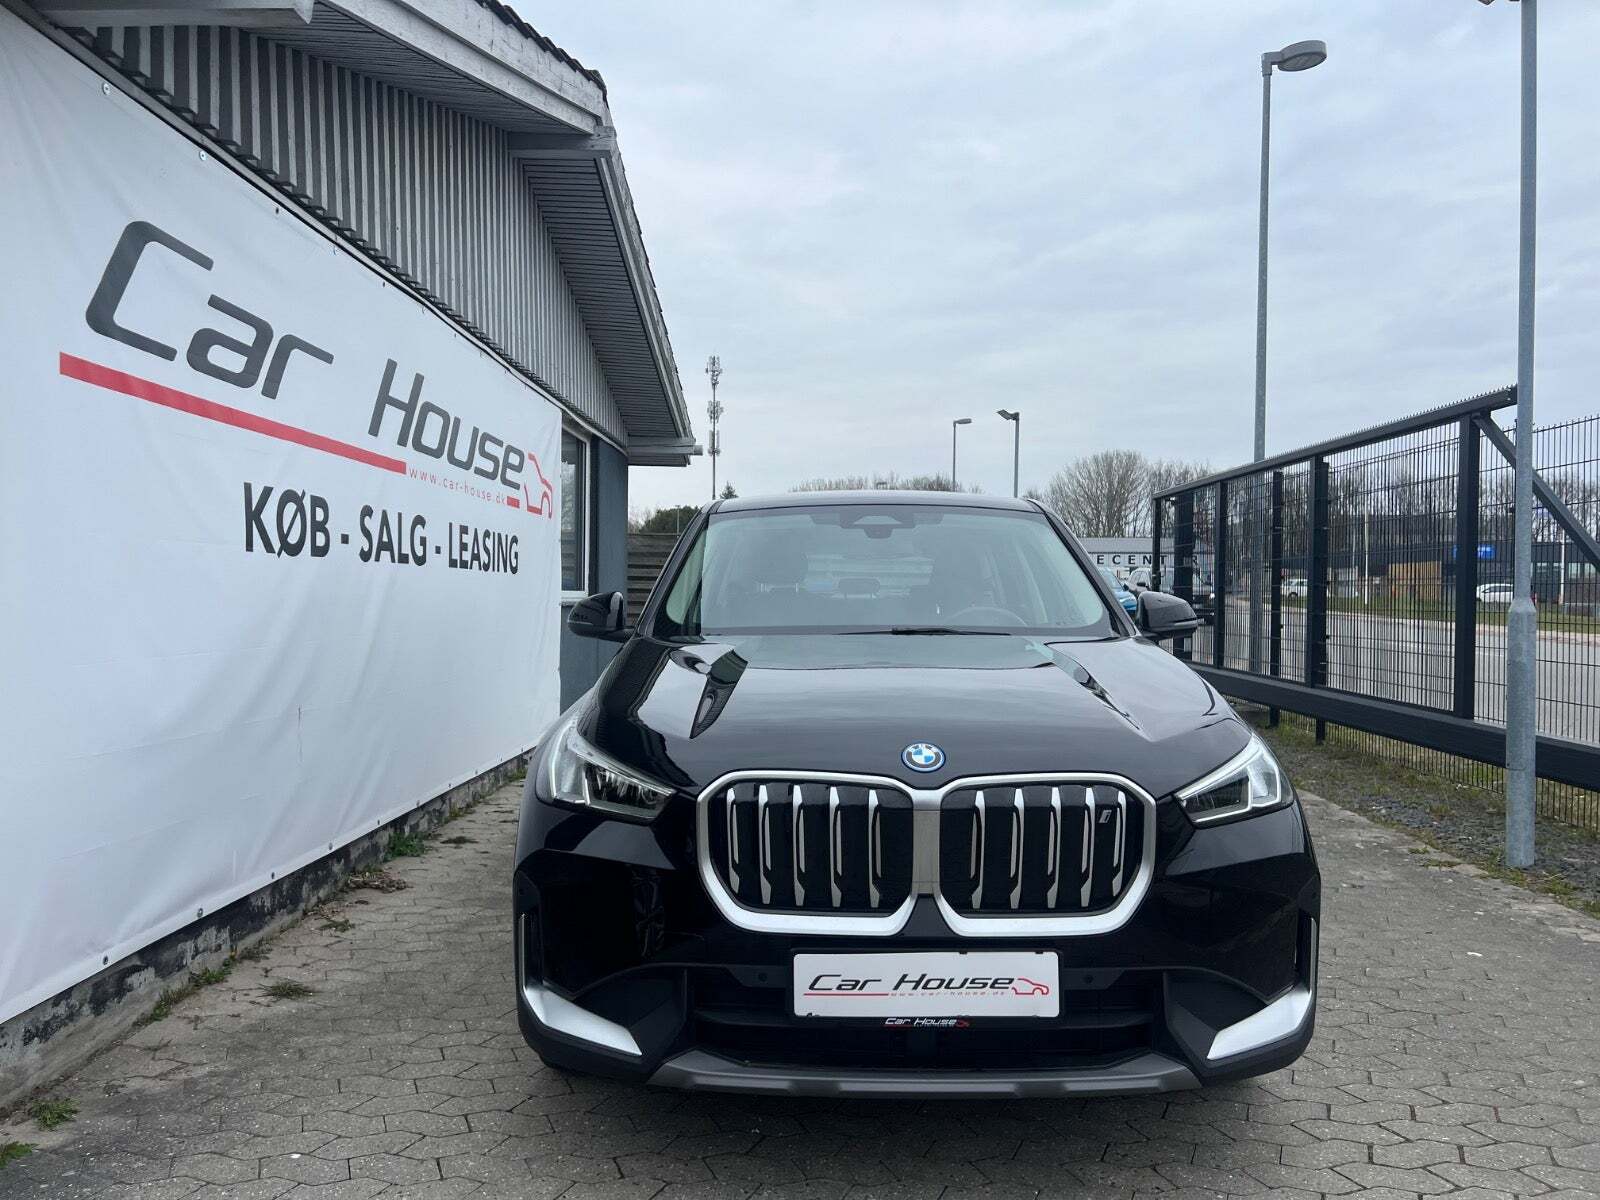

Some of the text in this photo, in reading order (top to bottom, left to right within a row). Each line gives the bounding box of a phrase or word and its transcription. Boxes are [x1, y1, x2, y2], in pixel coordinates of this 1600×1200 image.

[86, 220, 525, 490] Car House
[409, 467, 505, 505] www.car-house.dk
[243, 482, 331, 558] KØB
[359, 504, 427, 567] SALG
[448, 521, 519, 575] LEASING
[1096, 554, 1198, 566] ECENTR
[808, 973, 1015, 991] Car House
[884, 1017, 957, 1026] Car House
